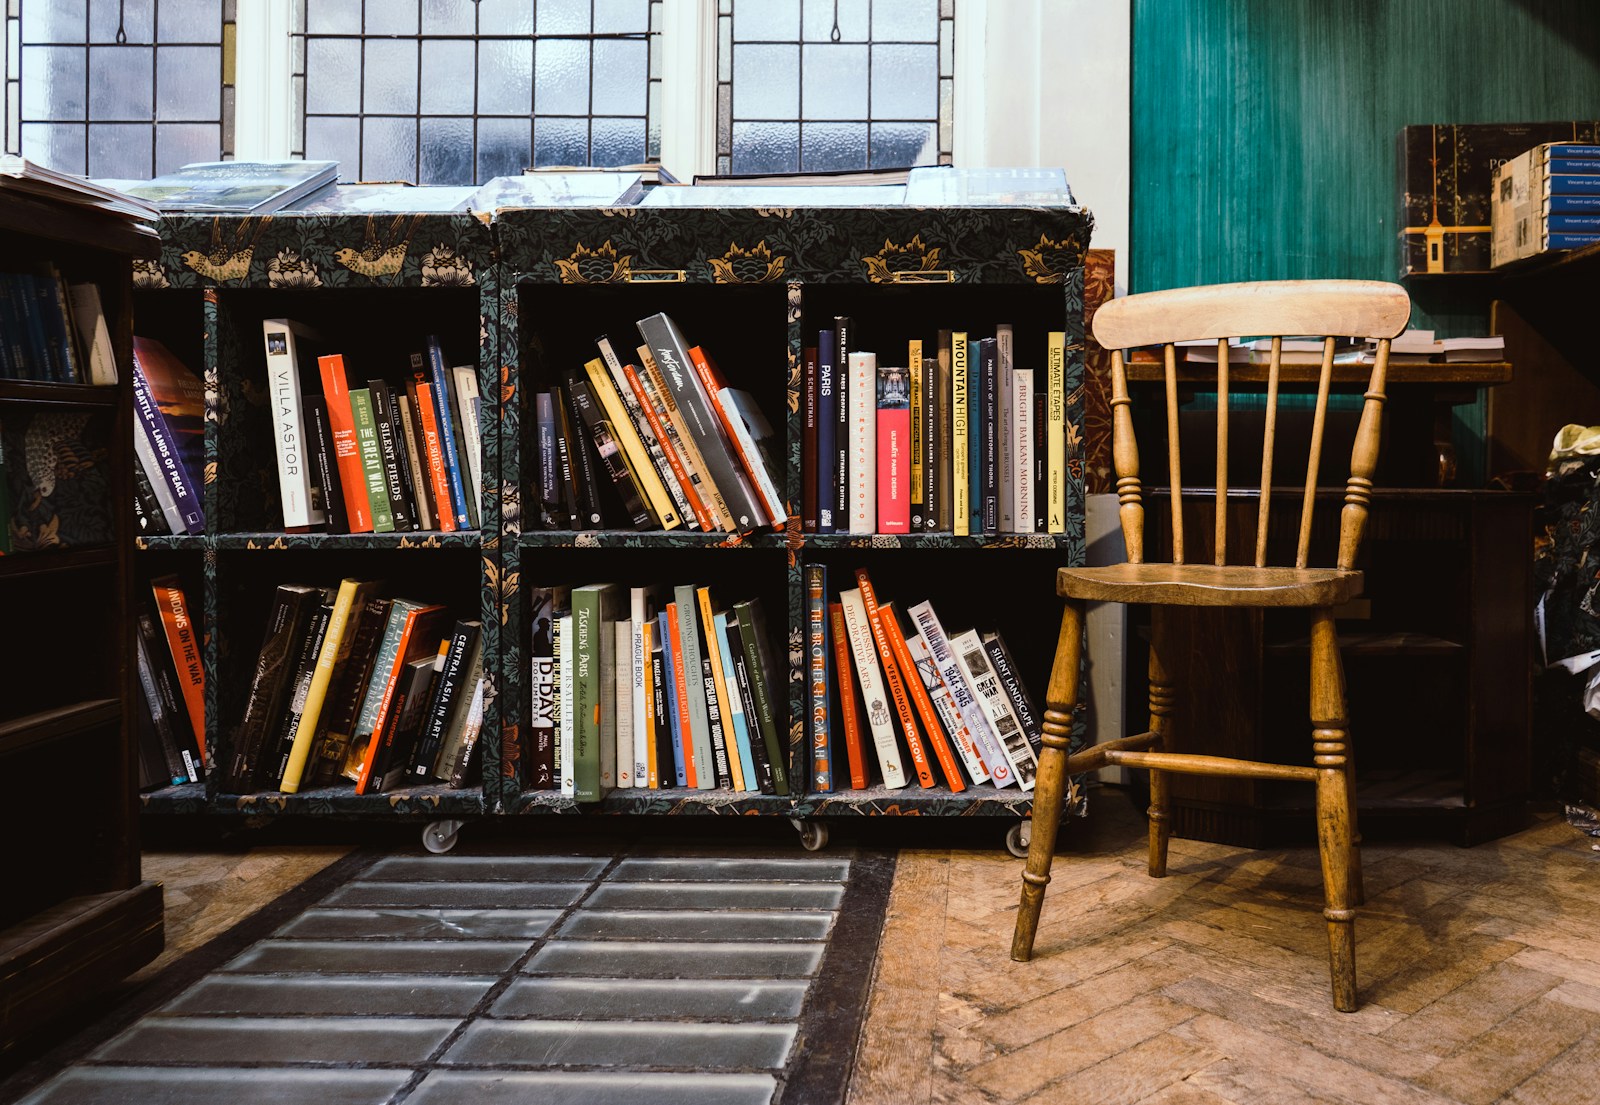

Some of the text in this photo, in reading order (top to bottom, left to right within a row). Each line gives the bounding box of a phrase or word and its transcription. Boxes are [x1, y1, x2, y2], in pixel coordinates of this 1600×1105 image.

[646, 357, 678, 412] STRADIVARIUS
[658, 349, 683, 391] Amsterdam
[821, 365, 830, 395] PARIS
[955, 340, 964, 435] MOUNTAIN HIGH
[356, 395, 369, 425] JOE SACCO
[987, 392, 992, 400] OF
[1053, 389, 1061, 420] ÉTAPES
[135, 389, 187, 497] BATTLE LANDS OF PEACE
[278, 371, 297, 475] VILLA ASTOR
[360, 428, 384, 493] THE GREAT WAR
[380, 422, 401, 500] SILENT FIELDS
[1019, 427, 1027, 464] BALKAN
[1020, 469, 1028, 519] MORNING
[178, 629, 189, 639] ON
[319, 614, 327, 633] ANTOINE
[389, 613, 398, 629] THE
[917, 610, 947, 662] THE ARDENNES
[183, 643, 196, 662] THE
[321, 641, 336, 668] BERLIN
[376, 630, 392, 675] PAINTINGS
[634, 633, 642, 664] PRAGUE
[683, 603, 698, 686] GROWING THOUGHTS
[846, 604, 871, 689] DECORATIVE ARTS
[860, 624, 875, 664] RUSSIAN
[188, 662, 202, 685] WAR
[552, 662, 560, 690] BLANC
[579, 654, 589, 677] PARIS
[748, 643, 757, 668] Gardens
[757, 681, 765, 703] Roman
[762, 703, 770, 722] World
[811, 607, 824, 758] THE BROTHER HAGGADAH
[858, 573, 923, 763] GABRIELE BASILICO VERTIGINOUS MOSCOW
[976, 676, 996, 692] GREAT
[287, 669, 313, 740] THE CRY OF SILENCE
[360, 684, 376, 726] FRESCOES
[381, 703, 387, 711] OF
[384, 686, 393, 703] DEATH
[431, 635, 466, 738] CENTRAL ASIA IN ART
[539, 662, 552, 721] D-DAY
[565, 659, 574, 731] VERSAILLES
[675, 652, 689, 723] MILAN HIGHLIGHTS
[704, 677, 718, 720] ESPELHO MEU
[944, 667, 969, 707] 1944-1945
[982, 686, 999, 698] WAR
[992, 648, 1011, 676] SILENT
[1006, 678, 1033, 726] LANDSCAPE
[376, 711, 385, 730] STALIN
[386, 694, 405, 747] NEVER REMEMBER
[460, 690, 485, 744] SANATORIUMS
[552, 693, 561, 723] MASSIF
[462, 740, 474, 767] SOVIET
[957, 730, 971, 753] BORDER
[716, 750, 728, 775] MIRROR
